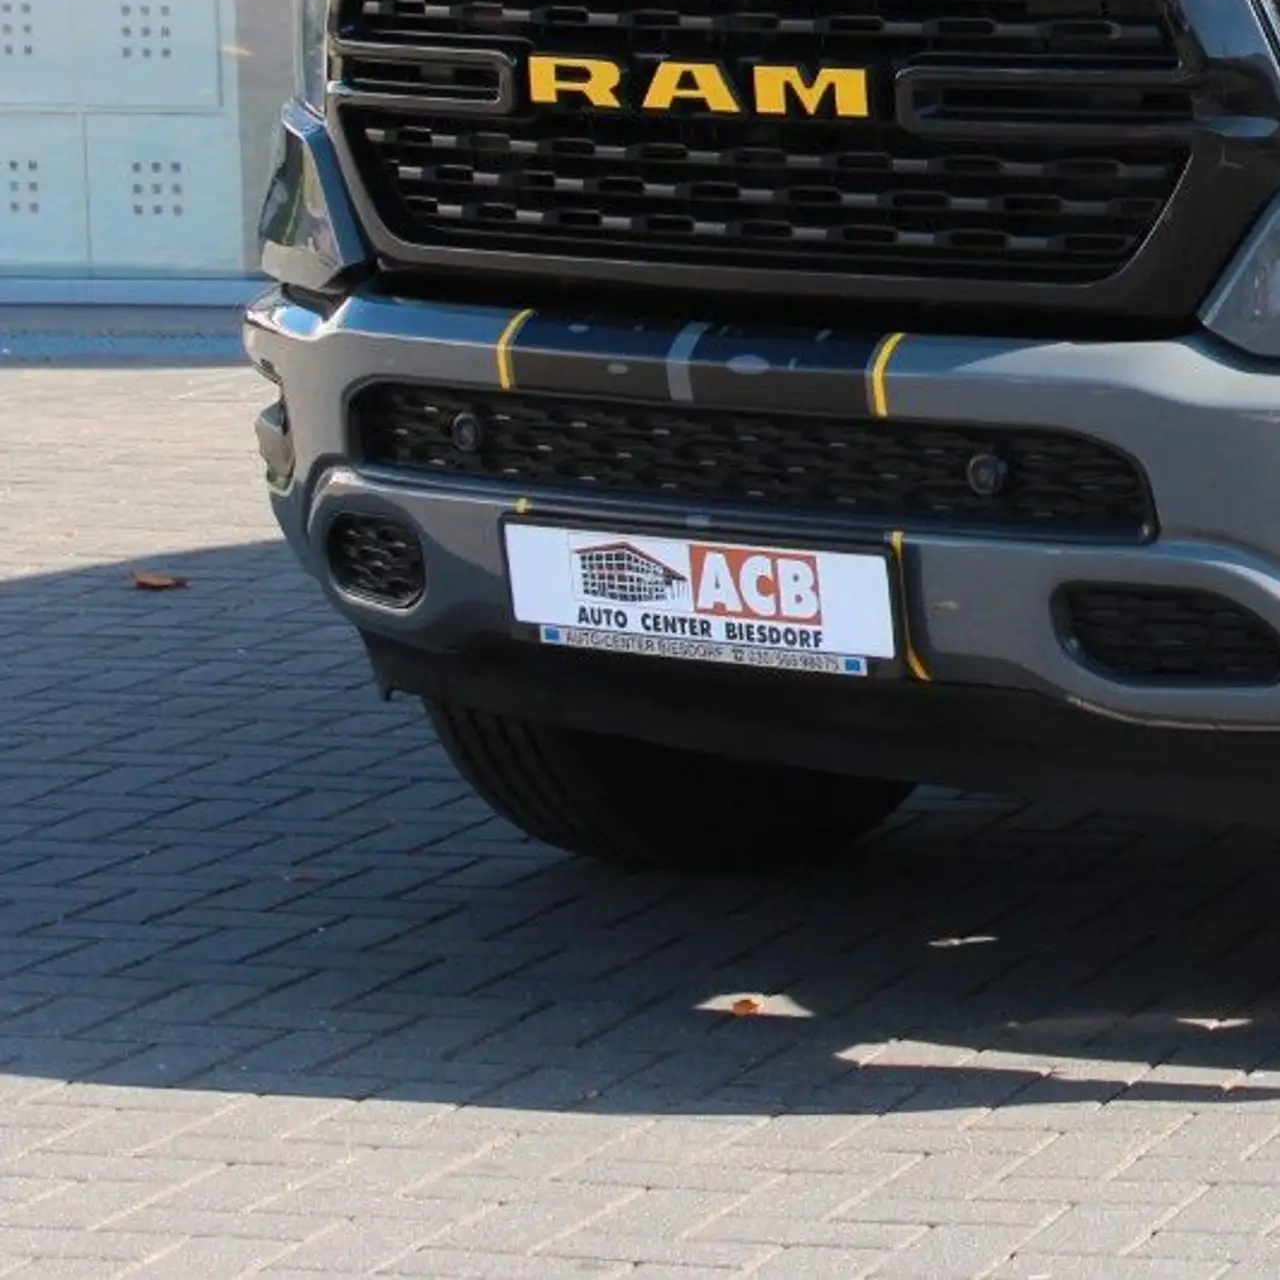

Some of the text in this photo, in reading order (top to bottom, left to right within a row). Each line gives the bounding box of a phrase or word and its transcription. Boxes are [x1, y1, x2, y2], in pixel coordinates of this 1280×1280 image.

[527, 54, 869, 118] RAM
[694, 549, 821, 619] ACB
[577, 605, 823, 649] AUTO CENTER BIESDORF
